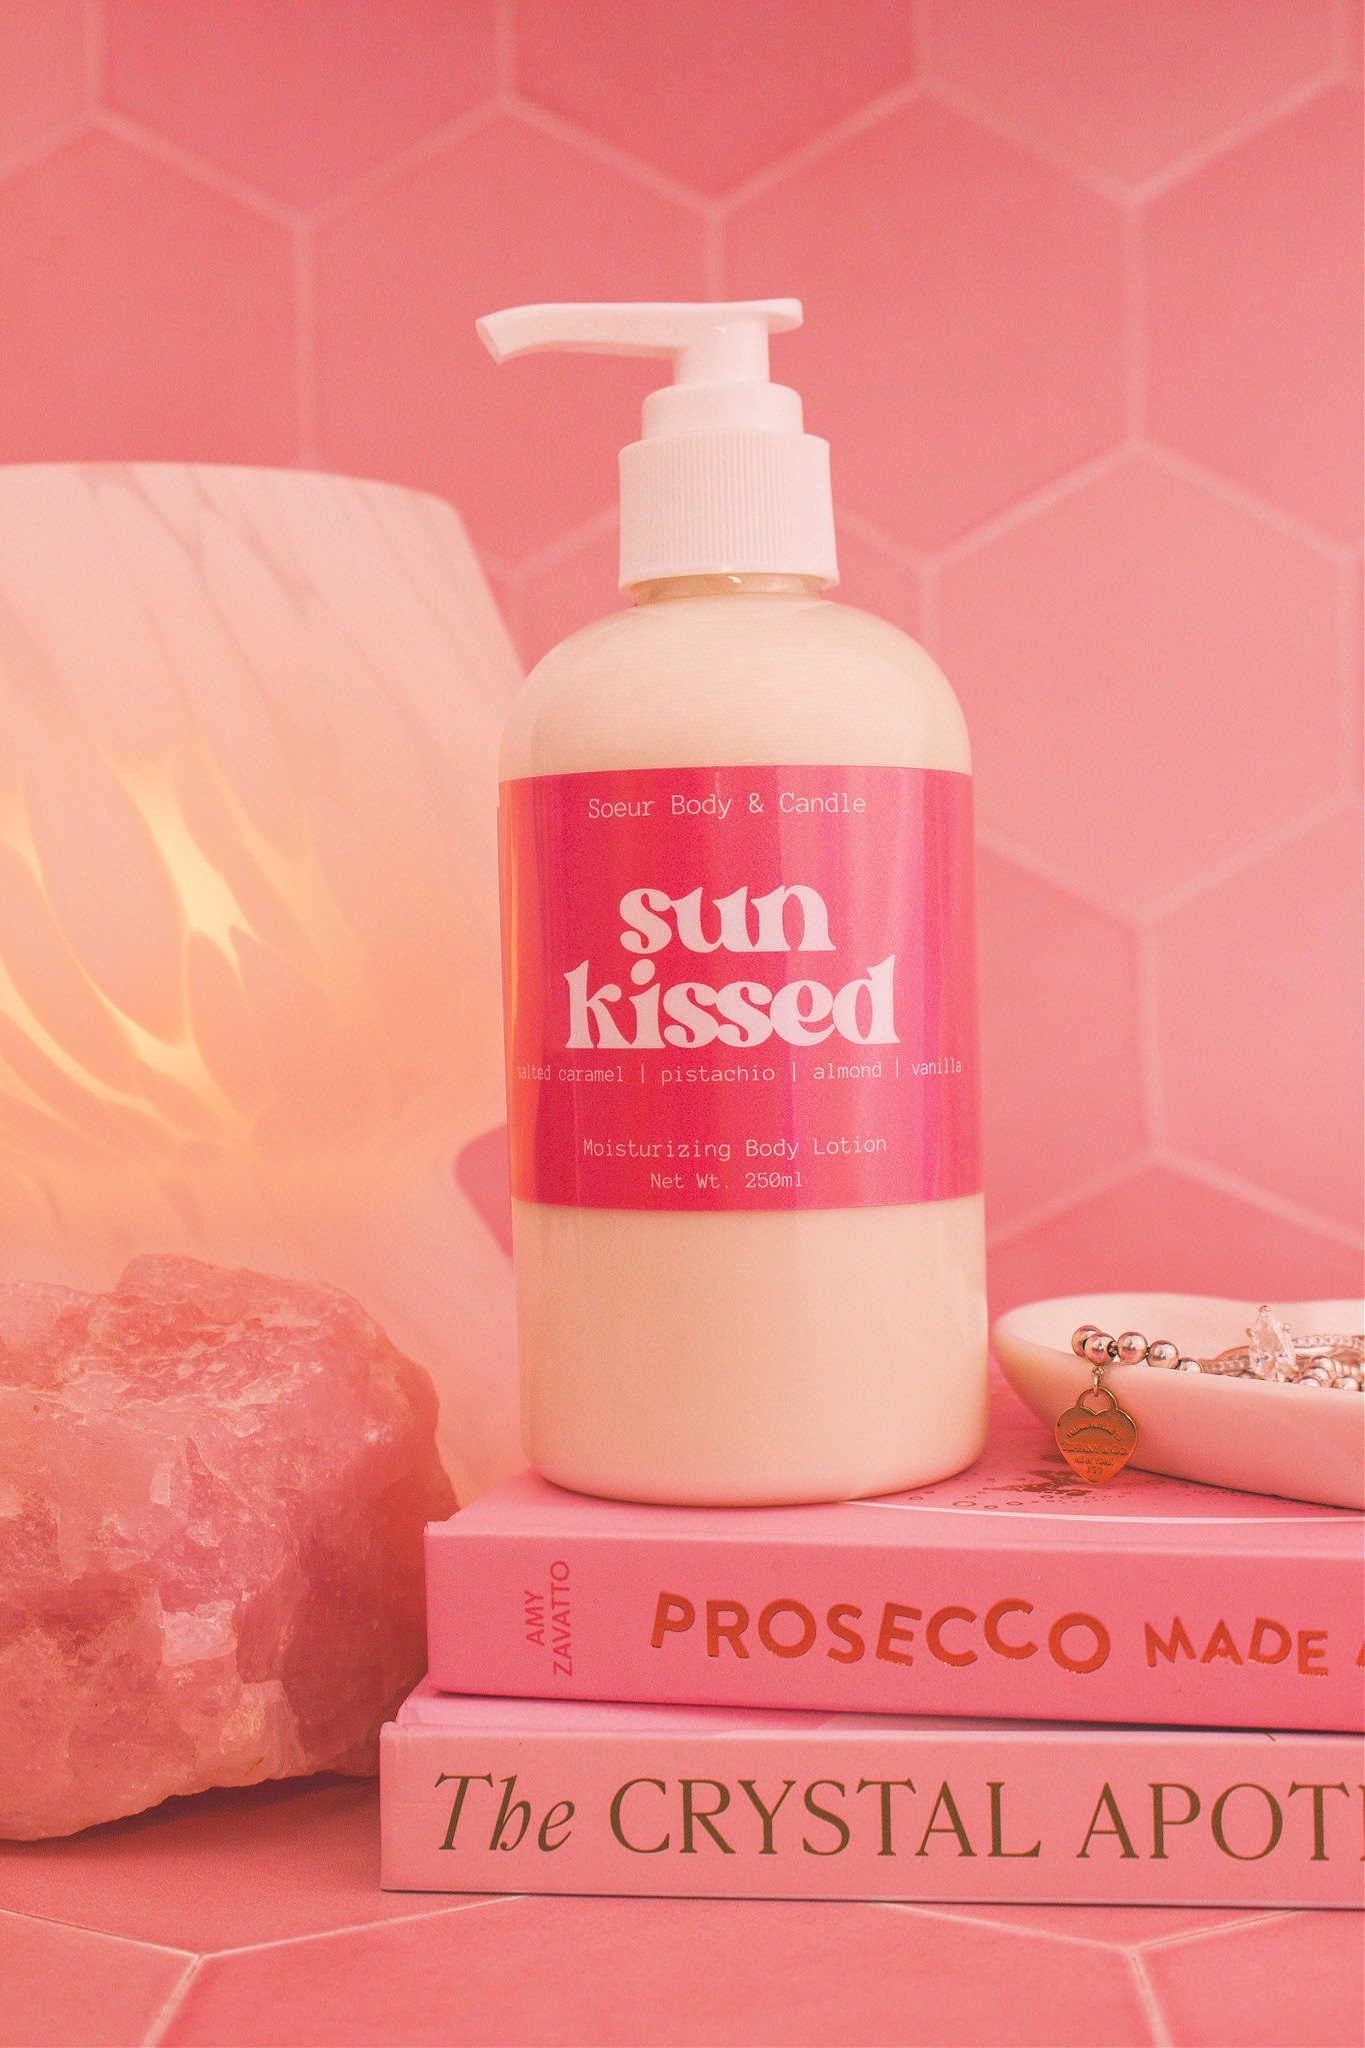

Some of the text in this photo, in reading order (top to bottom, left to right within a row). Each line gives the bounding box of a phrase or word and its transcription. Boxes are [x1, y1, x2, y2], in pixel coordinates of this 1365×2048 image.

[588, 791, 866, 820] Soeur Body & Candle
[619, 884, 837, 955] sun
[564, 954, 901, 1050] kissed
[558, 1065, 624, 1083] caramel
[660, 1061, 776, 1085] pistachio
[812, 1061, 883, 1081] almond
[911, 1057, 963, 1077] vanilla
[583, 1136, 887, 1162] Moisturizing Body Lotion
[650, 1171, 804, 1190] Net Wt. 250ml
[524, 1589, 546, 1648] AMY
[551, 1559, 573, 1678] ZAVATTO
[650, 1590, 1112, 1675] PROSECCO
[1145, 1614, 1329, 1677] MADE
[433, 1771, 1364, 1862] The CRYSTAL APOT
